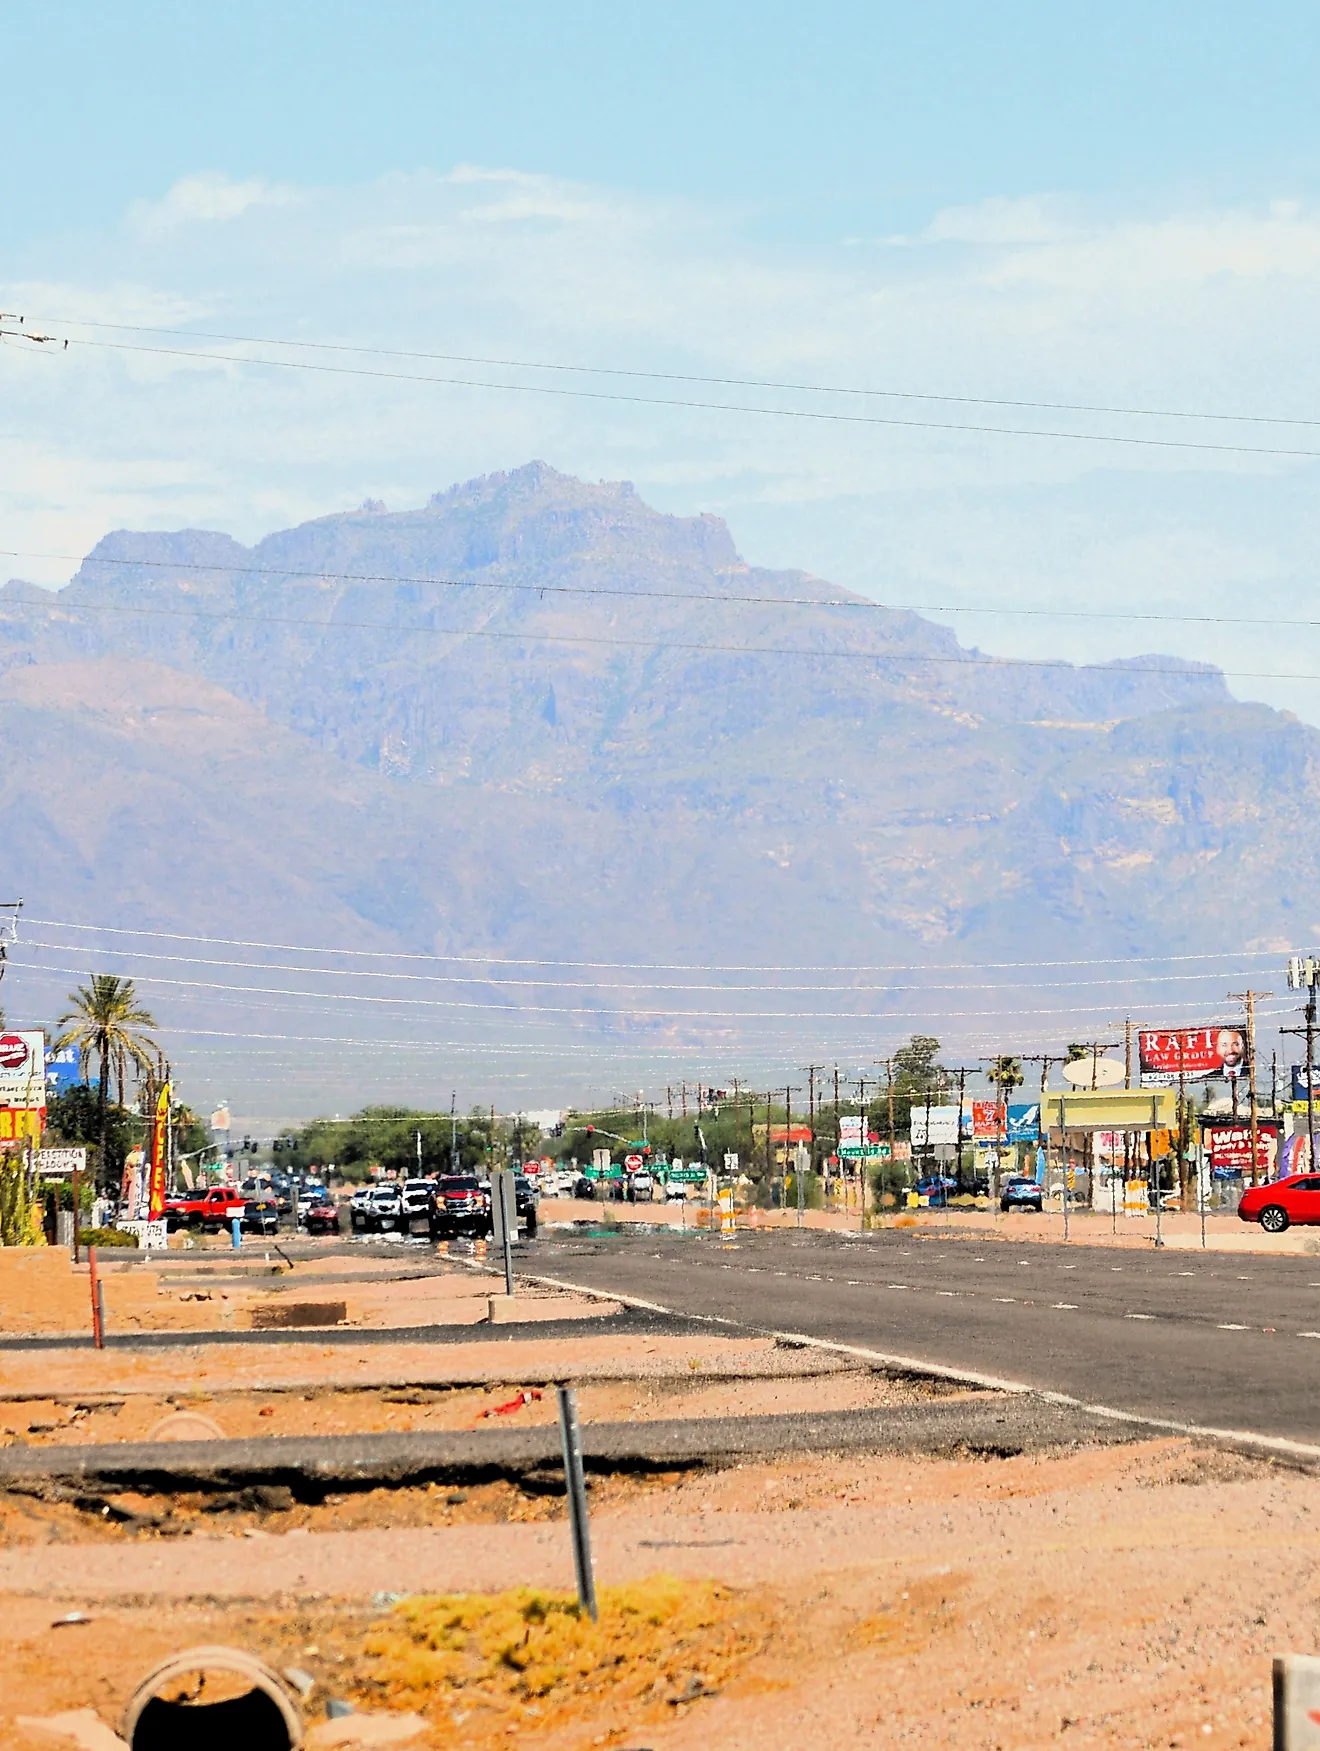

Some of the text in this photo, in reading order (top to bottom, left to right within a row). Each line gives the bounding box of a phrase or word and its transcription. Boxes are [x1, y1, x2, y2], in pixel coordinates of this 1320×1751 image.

[1145, 1030, 1213, 1051] RAFI
[1146, 1050, 1214, 1062] LAW GROUP
